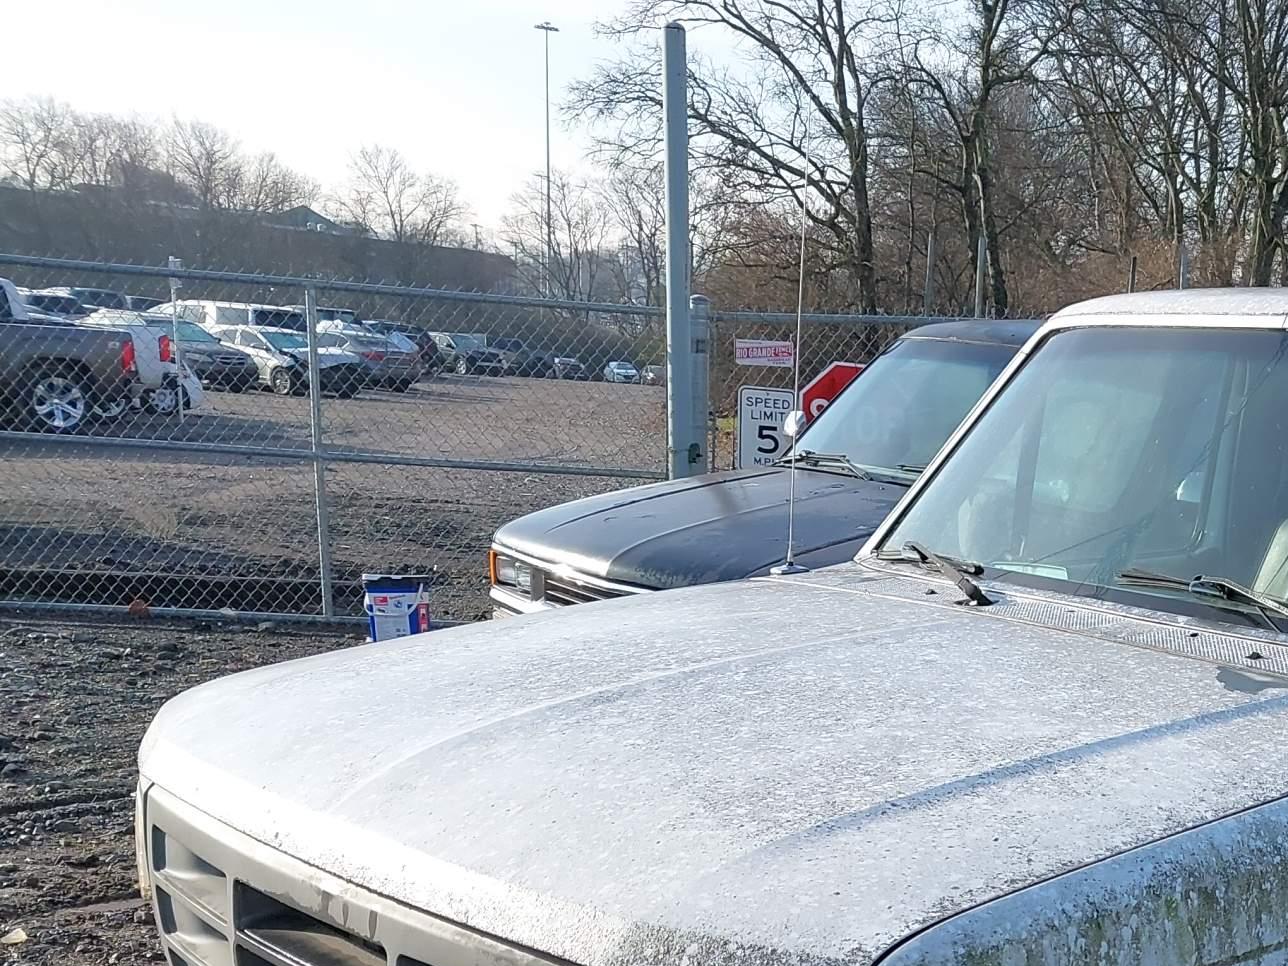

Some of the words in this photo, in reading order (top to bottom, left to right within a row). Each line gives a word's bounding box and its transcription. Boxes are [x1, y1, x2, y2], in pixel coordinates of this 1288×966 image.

[736, 347, 748, 358] RIO
[748, 347, 775, 358] GRANDE
[746, 396, 790, 409] SPEED
[751, 410, 786, 421] LIMIT
[757, 425, 779, 454] 5
